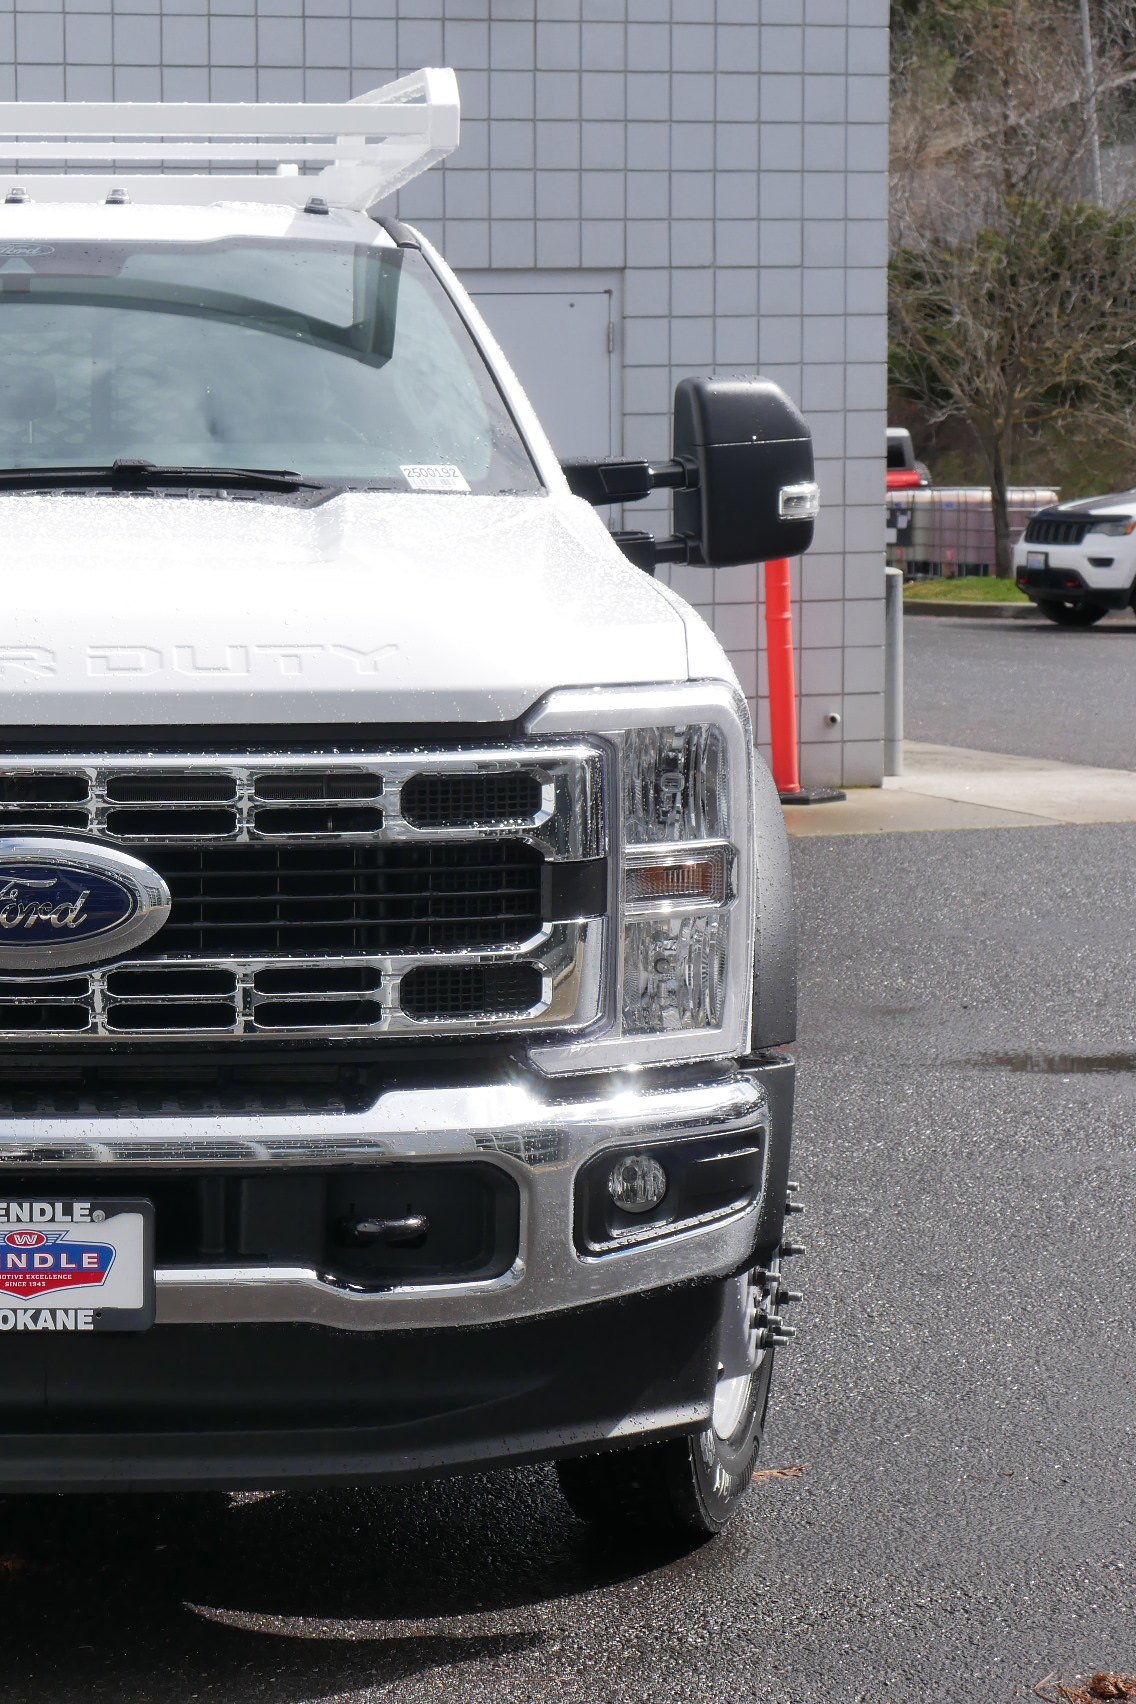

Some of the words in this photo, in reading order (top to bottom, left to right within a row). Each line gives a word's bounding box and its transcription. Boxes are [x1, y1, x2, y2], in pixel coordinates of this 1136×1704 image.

[404, 467, 459, 478] 2500192
[86, 643, 399, 677] DUTY
[14, 1234, 38, 1245] W
